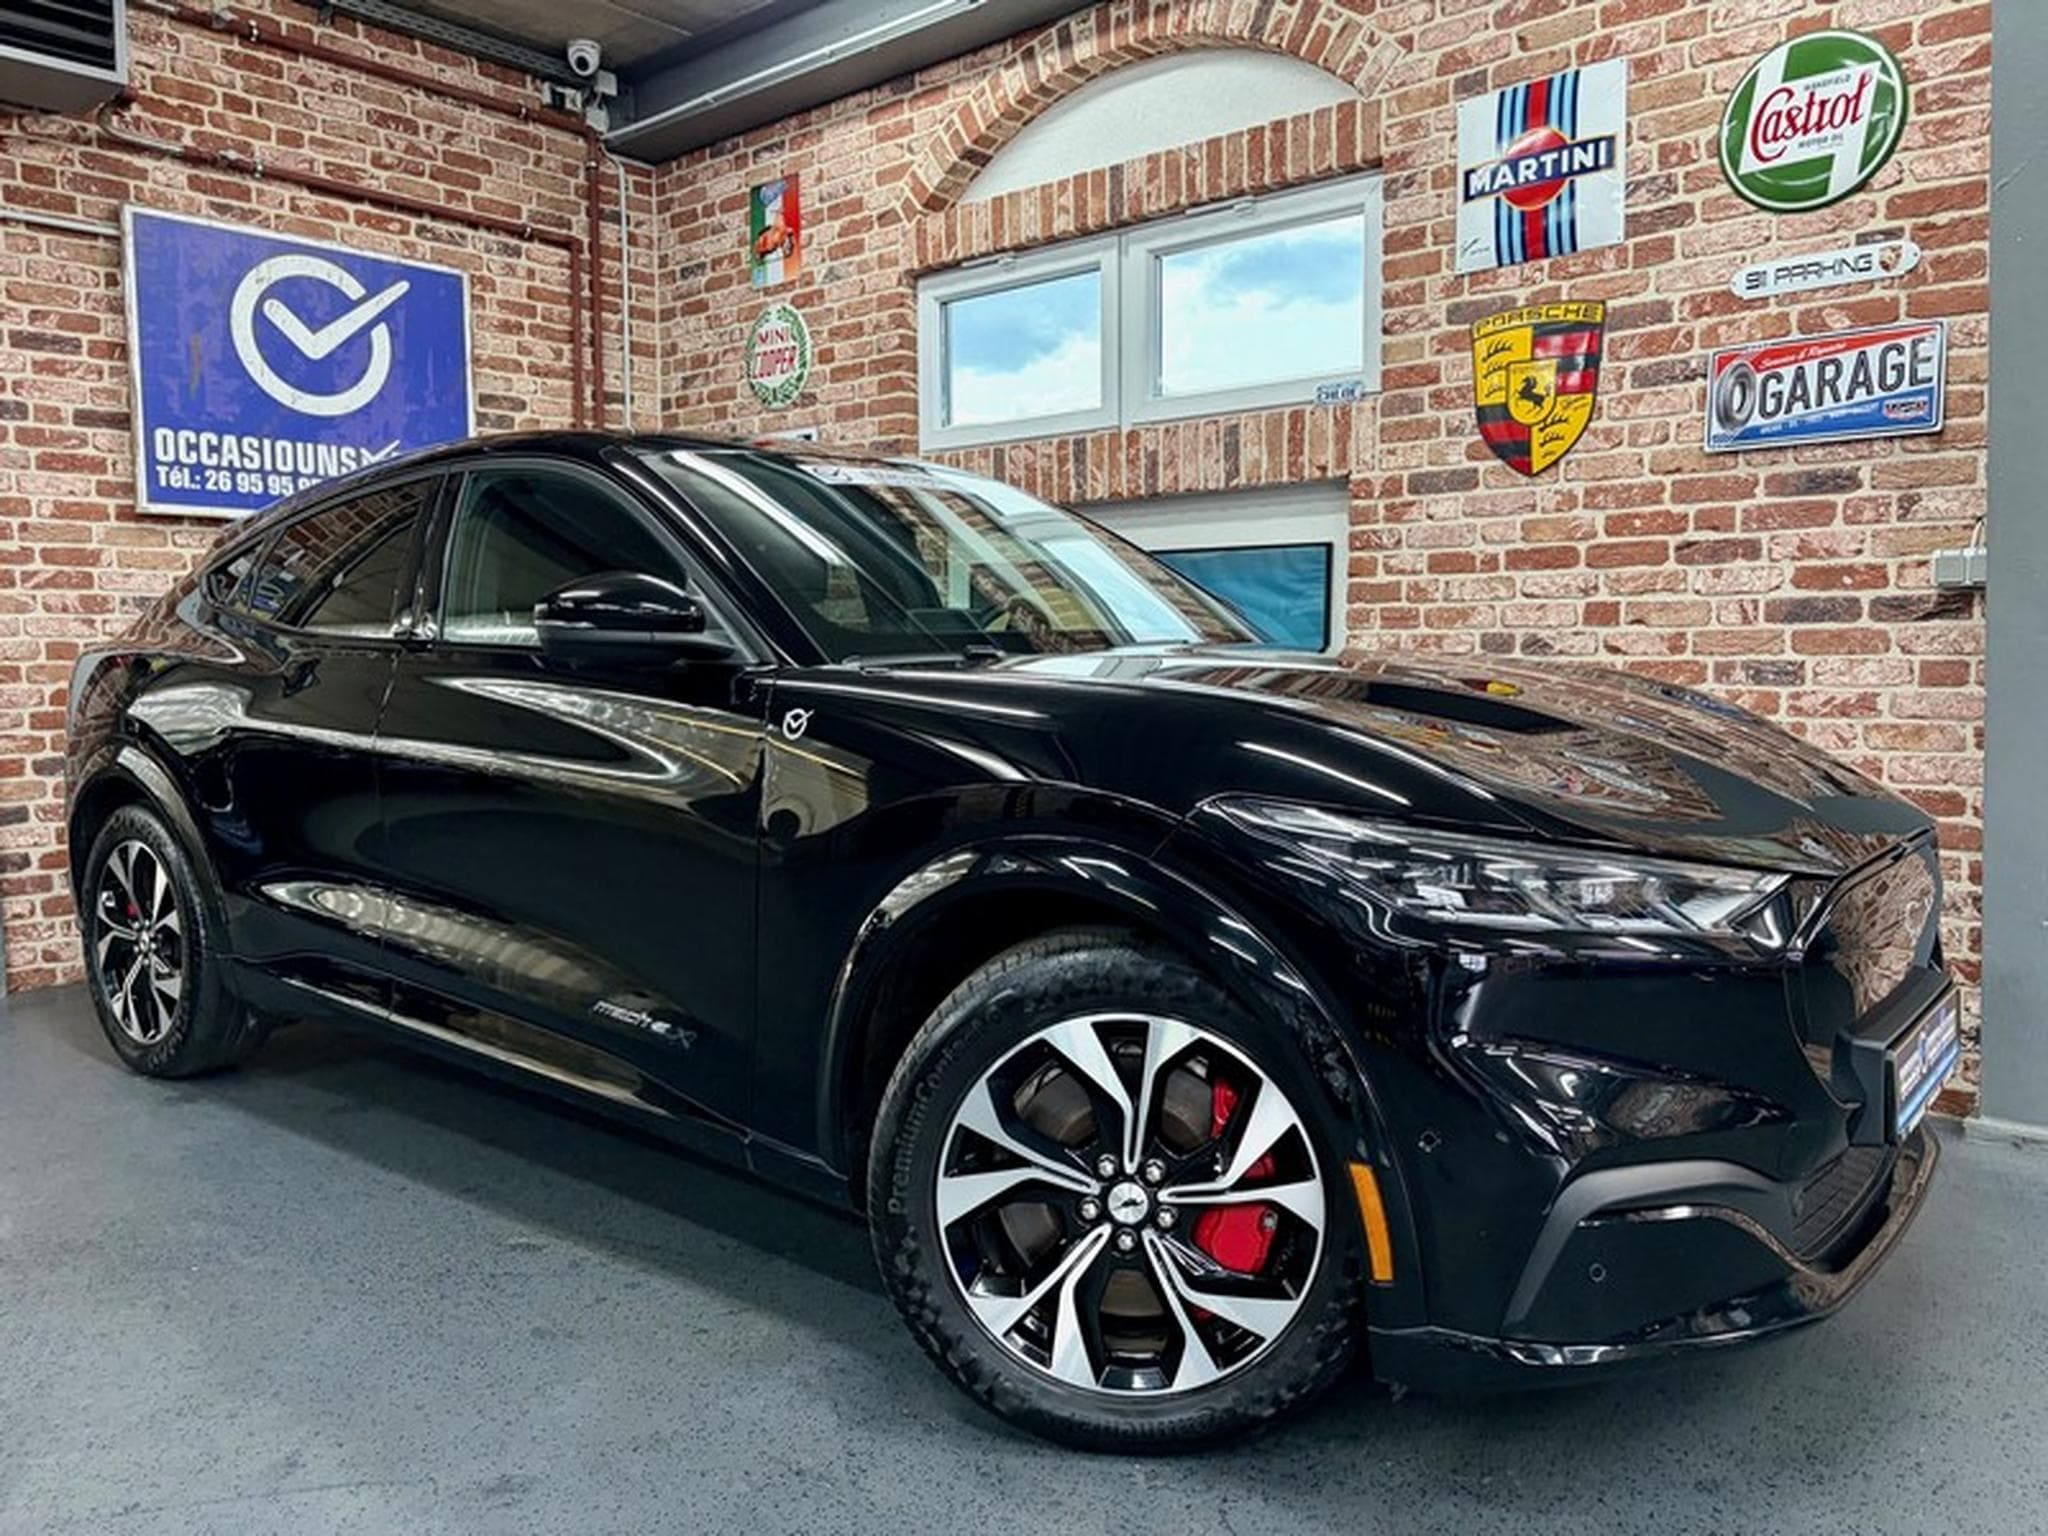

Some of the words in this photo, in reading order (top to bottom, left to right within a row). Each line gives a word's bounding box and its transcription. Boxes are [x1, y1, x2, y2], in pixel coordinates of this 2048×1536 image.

[1751, 70, 1873, 163] Castrol
[1469, 141, 1608, 196] MARTINI
[1774, 252, 1873, 285] PARKING
[758, 326, 790, 345] MINI
[1476, 306, 1600, 337] PORSCHE
[753, 345, 797, 379] COOPER
[1758, 333, 1936, 420] GARAGE
[205, 468, 232, 492] 26
[236, 471, 263, 495] 95
[267, 475, 294, 497] 95
